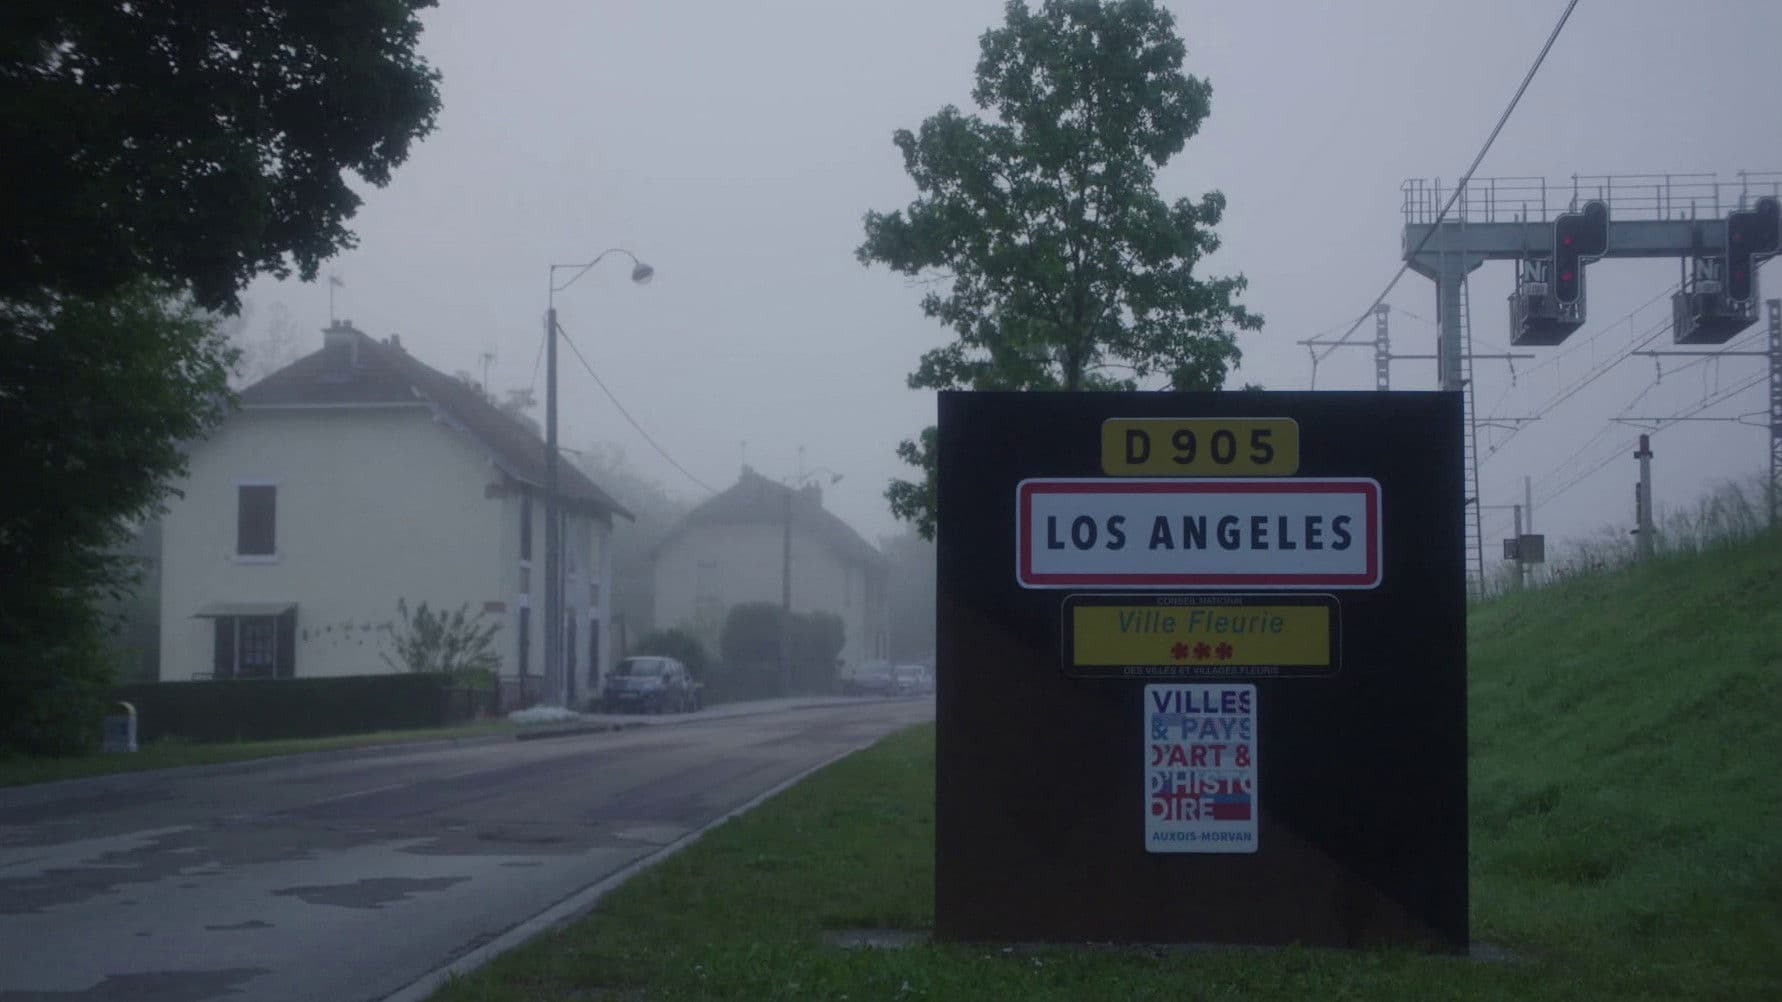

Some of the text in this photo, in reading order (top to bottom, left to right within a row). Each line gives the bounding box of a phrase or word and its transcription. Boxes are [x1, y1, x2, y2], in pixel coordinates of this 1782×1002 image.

[1126, 429, 1275, 465] D 905
[1047, 515, 1353, 550] LOS ANGELES
[1119, 610, 1284, 634] Ville Fleurie
[1152, 690, 1250, 713] VILLES
[1181, 717, 1250, 740] PAYS
[1235, 744, 1250, 767] &
[1152, 831, 1251, 841] AUXOIS-MORVAN
